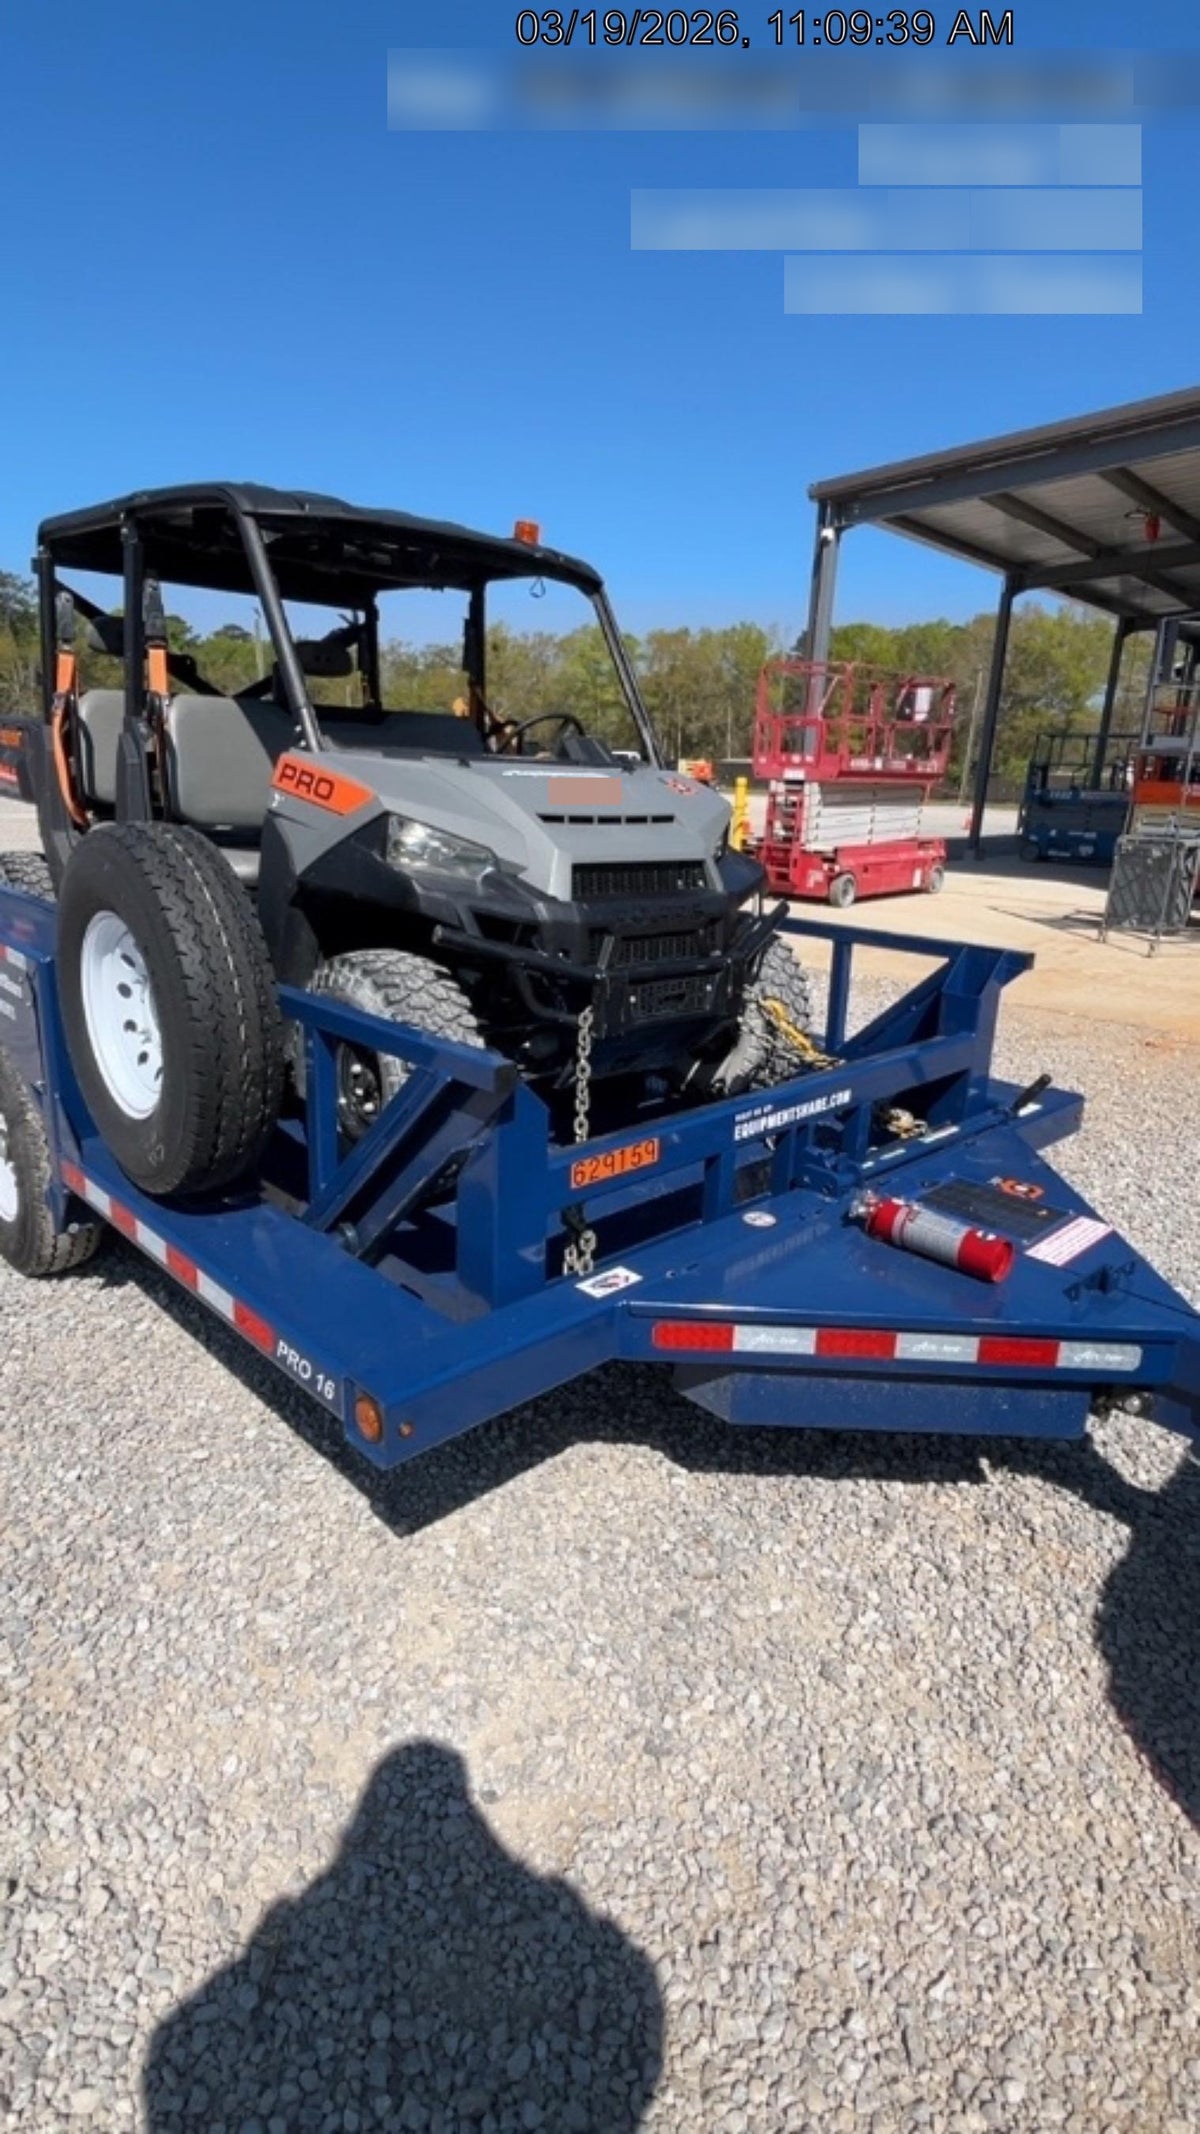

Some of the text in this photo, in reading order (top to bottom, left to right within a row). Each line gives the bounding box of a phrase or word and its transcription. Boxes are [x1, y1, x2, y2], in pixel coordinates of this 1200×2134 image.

[278, 763, 335, 801] PRO
[574, 1140, 655, 1186] 629159
[277, 1339, 336, 1400] PRO 16
